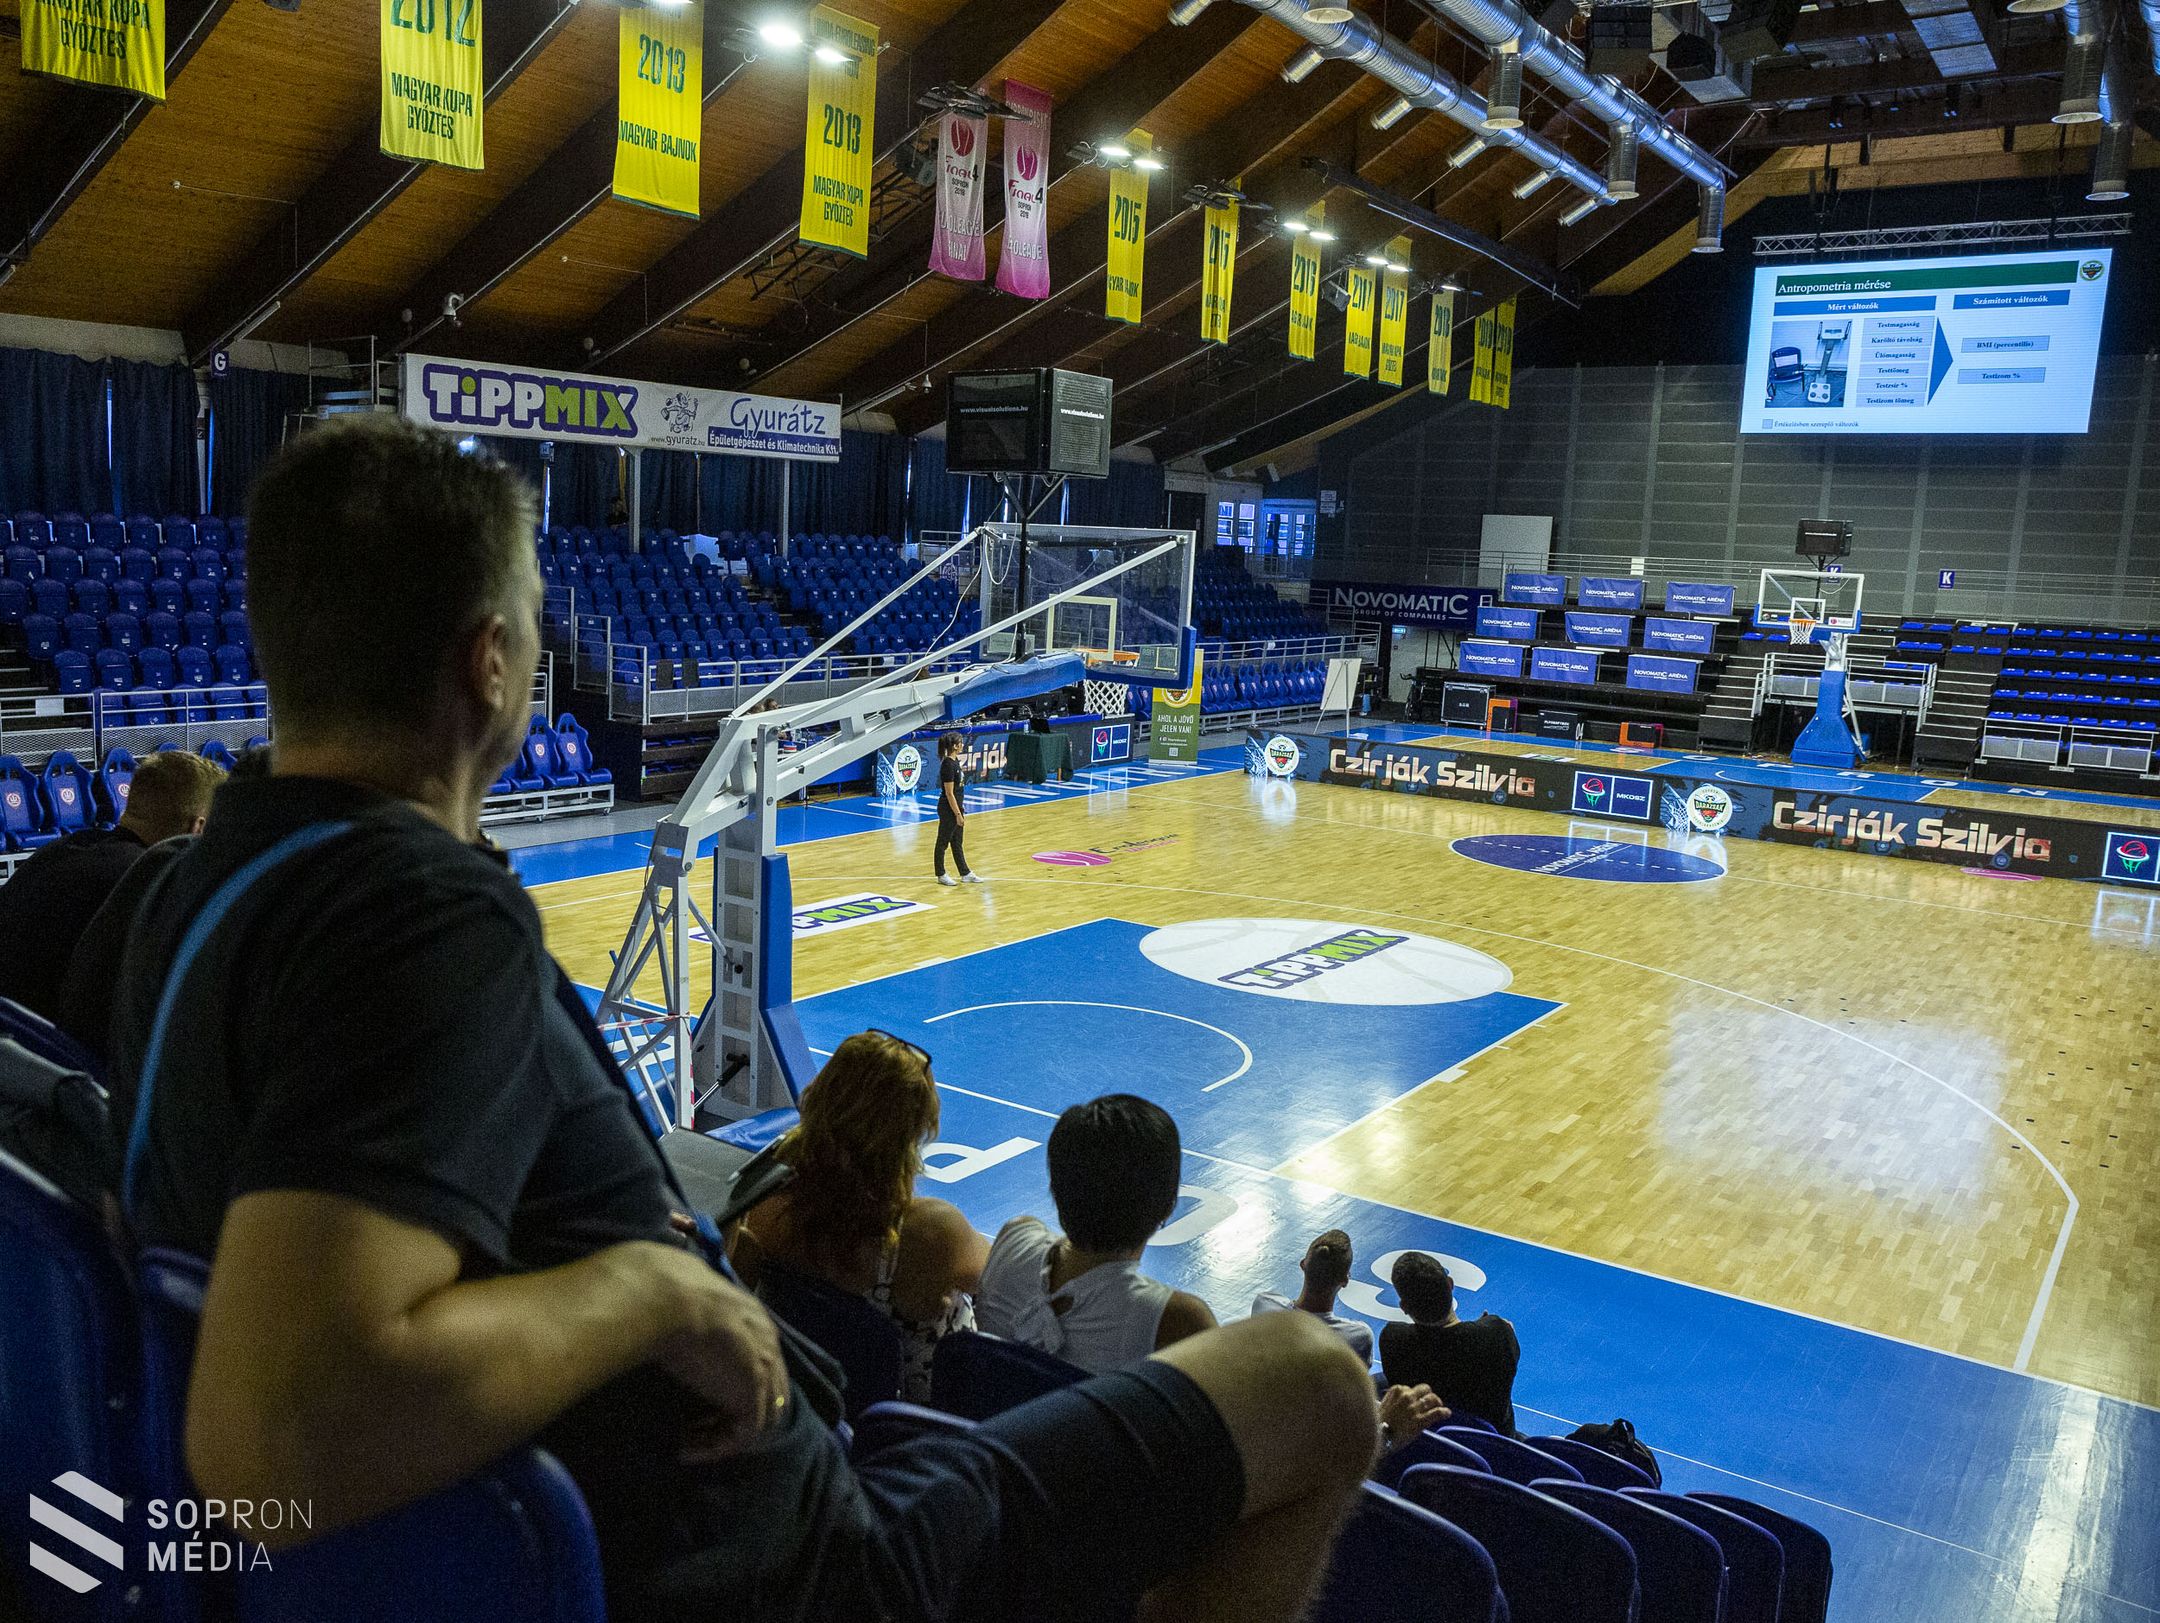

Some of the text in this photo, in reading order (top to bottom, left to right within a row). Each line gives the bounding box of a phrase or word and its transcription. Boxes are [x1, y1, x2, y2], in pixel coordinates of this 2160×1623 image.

[637, 34, 686, 94] 2013
[391, 72, 473, 118] MAGYAR KUPA
[407, 104, 454, 140] GYŐZTES
[823, 104, 862, 155] 2013
[618, 120, 697, 163] MAGYAR BAJNOK
[813, 175, 846, 200] MAGYAR
[1114, 194, 1142, 245] 2015
[1778, 280, 1891, 294] Antropometria mérése
[1848, 302, 1879, 310] változók
[1973, 295, 2049, 305] Számított változók
[214, 352, 227, 371] G
[730, 397, 826, 438] Gyurátz
[709, 431, 766, 450] Épületgépészet
[768, 440, 776, 450] és
[777, 440, 825, 454] Klimatechnika
[1942, 572, 1952, 585] K
[1335, 587, 1469, 615] NOVOMATIC
[1355, 608, 1381, 616] GROUP
[1398, 613, 1446, 621] COMPANIES
[1483, 618, 1512, 626] NOVOMATIC
[1466, 654, 1497, 662] NOVOMATIC
[1538, 661, 1569, 669] NOVOMATIC
[1634, 669, 1667, 677] NOVOMATIC
[1160, 725, 1177, 733] JELEN
[1330, 748, 1535, 798] Czirják Szilvia
[1616, 793, 1645, 801] MKOSZ
[1773, 801, 2051, 863] Czirják Szilvia
